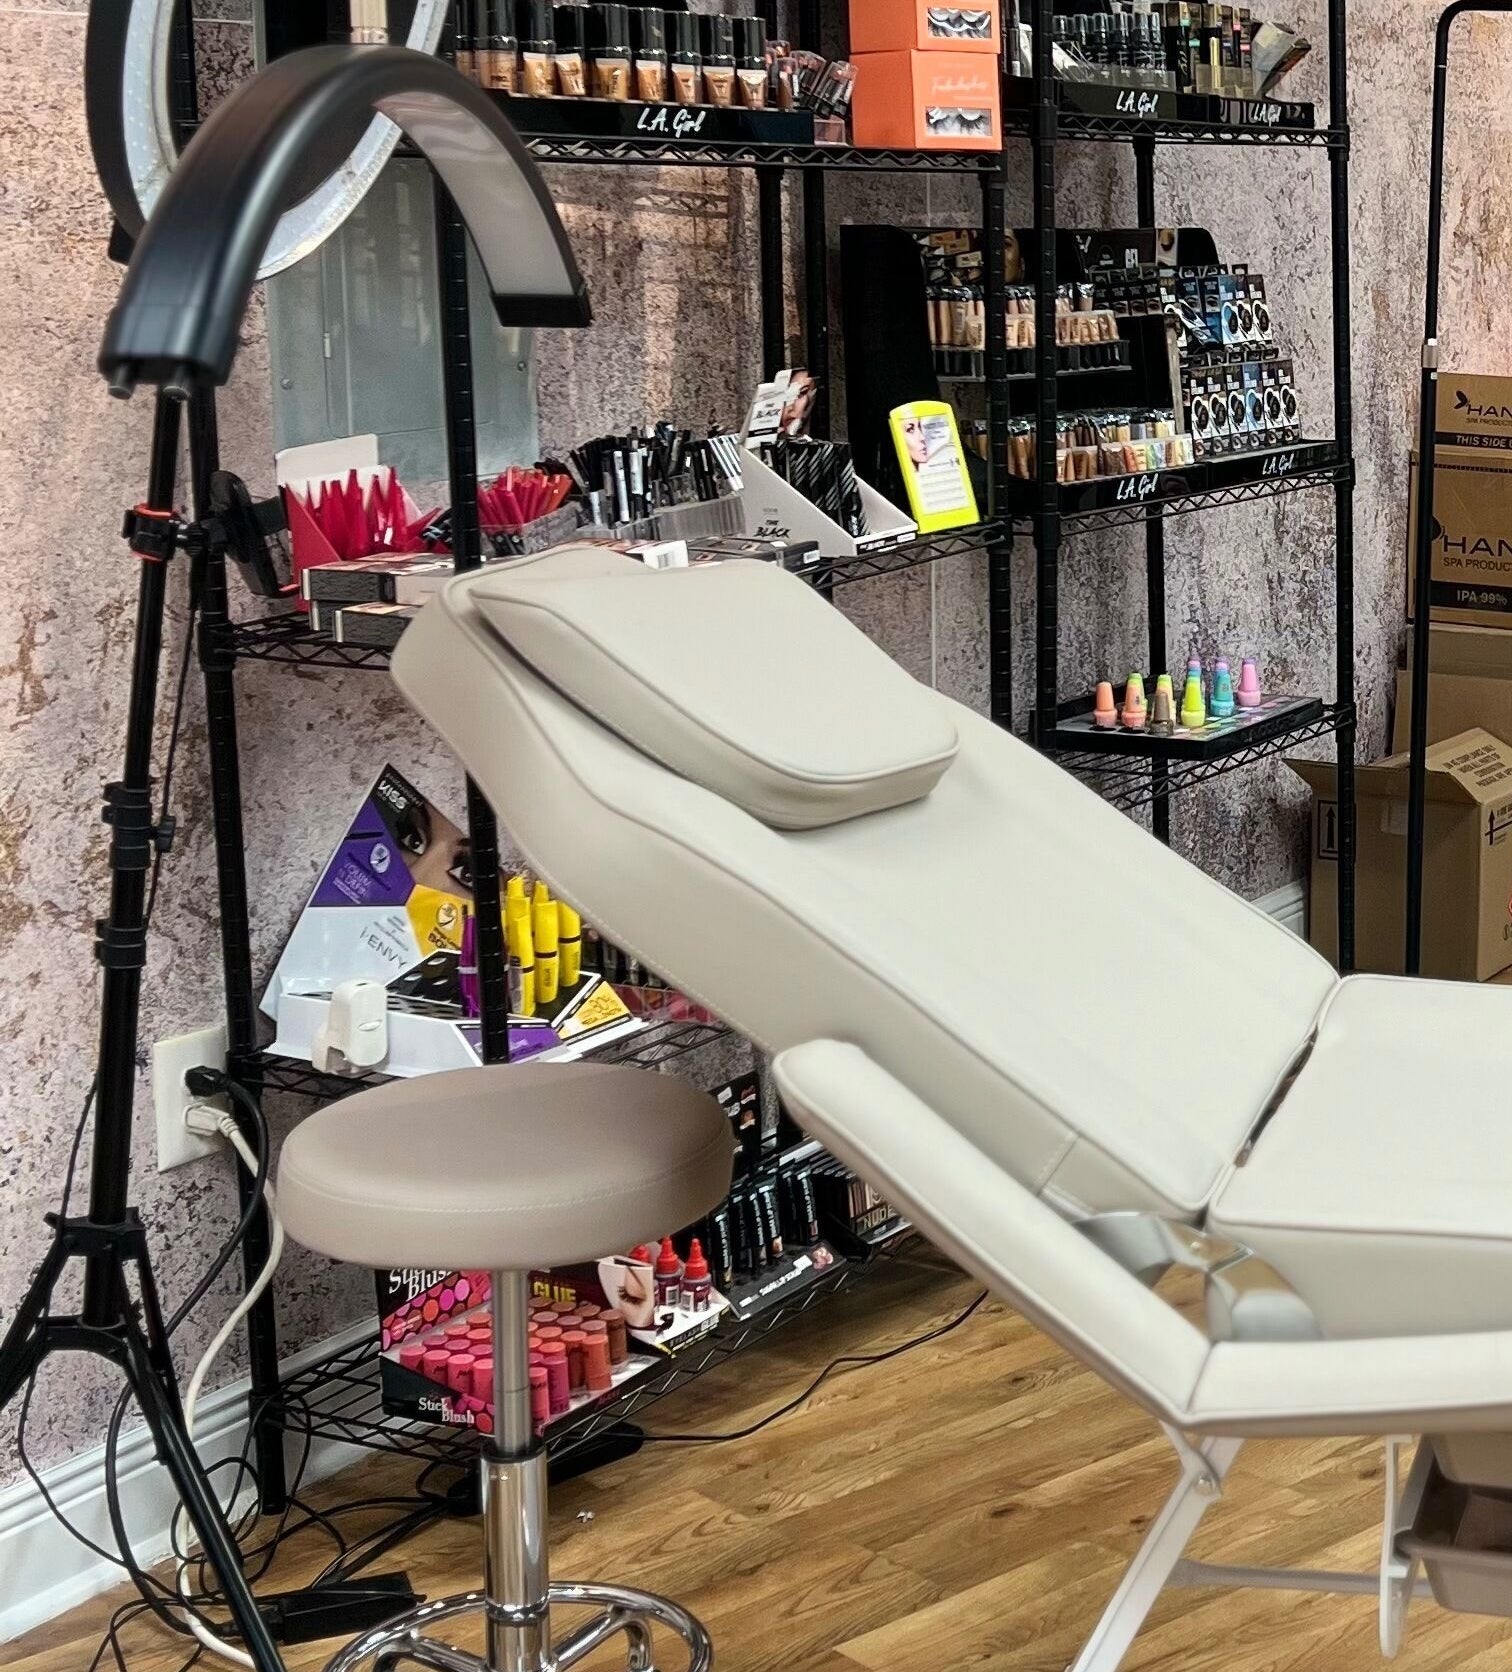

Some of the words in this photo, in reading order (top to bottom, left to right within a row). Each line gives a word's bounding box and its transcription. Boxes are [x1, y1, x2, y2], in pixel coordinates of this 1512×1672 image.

[672, 110, 707, 138] Girl
[1466, 417, 1478, 426] SPA
[1456, 435, 1480, 447] THIS
[1481, 437, 1507, 449] SIDE
[753, 526, 792, 538] BLACK
[1443, 556, 1464, 569] SPA
[1457, 589, 1478, 603] IPA
[377, 779, 407, 809] KISS
[533, 1281, 577, 1304] GLUE
[418, 1397, 449, 1412] Stick
[441, 1409, 475, 1424] Blush
